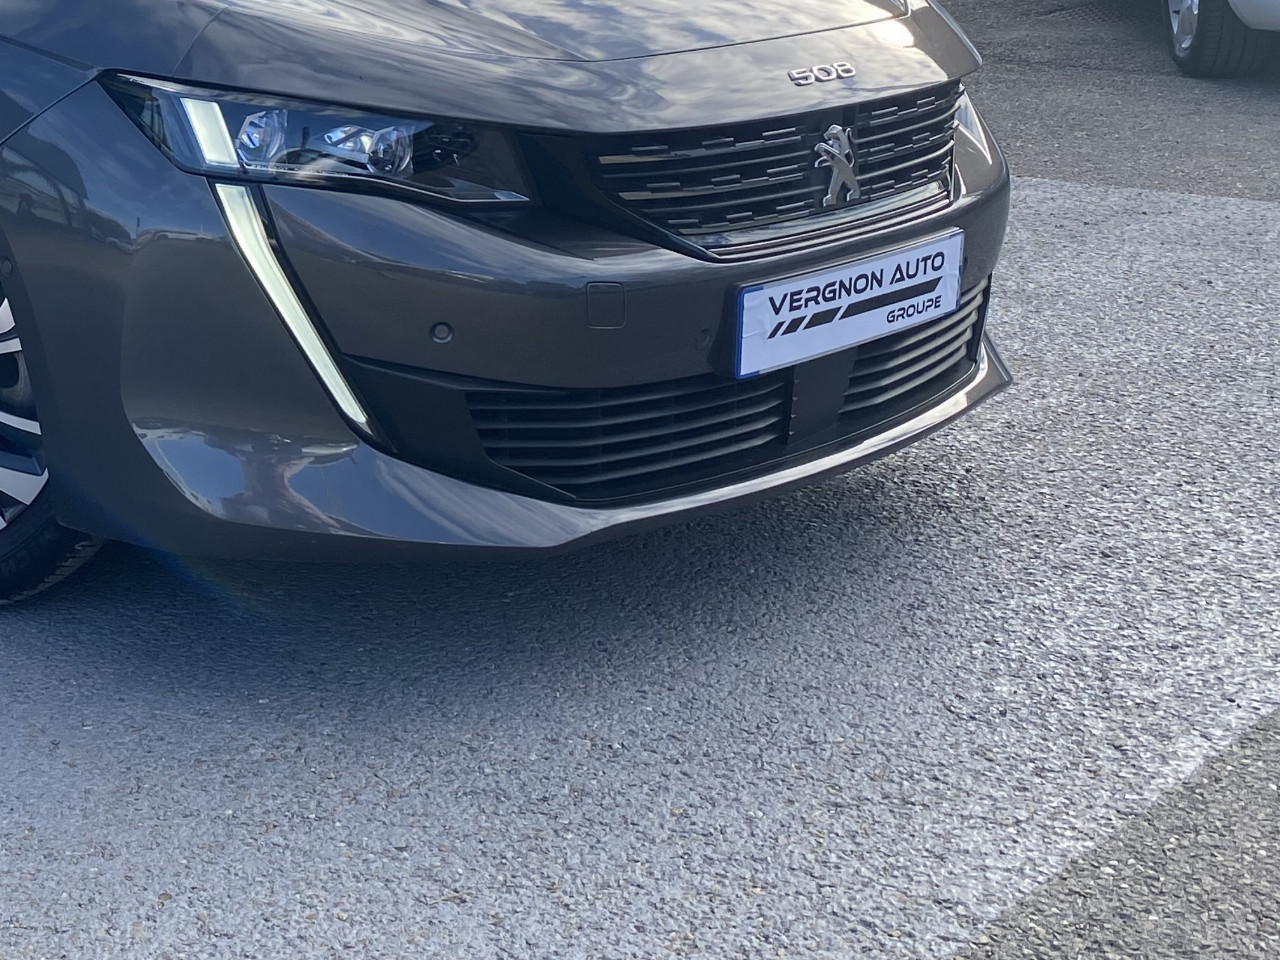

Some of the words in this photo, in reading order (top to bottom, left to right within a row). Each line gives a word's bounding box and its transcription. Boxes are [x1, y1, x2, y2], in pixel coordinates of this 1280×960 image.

[788, 61, 856, 86] 508
[768, 268, 884, 316] VERGNON
[889, 251, 945, 285] AUTO
[886, 295, 943, 324] GROUPE
